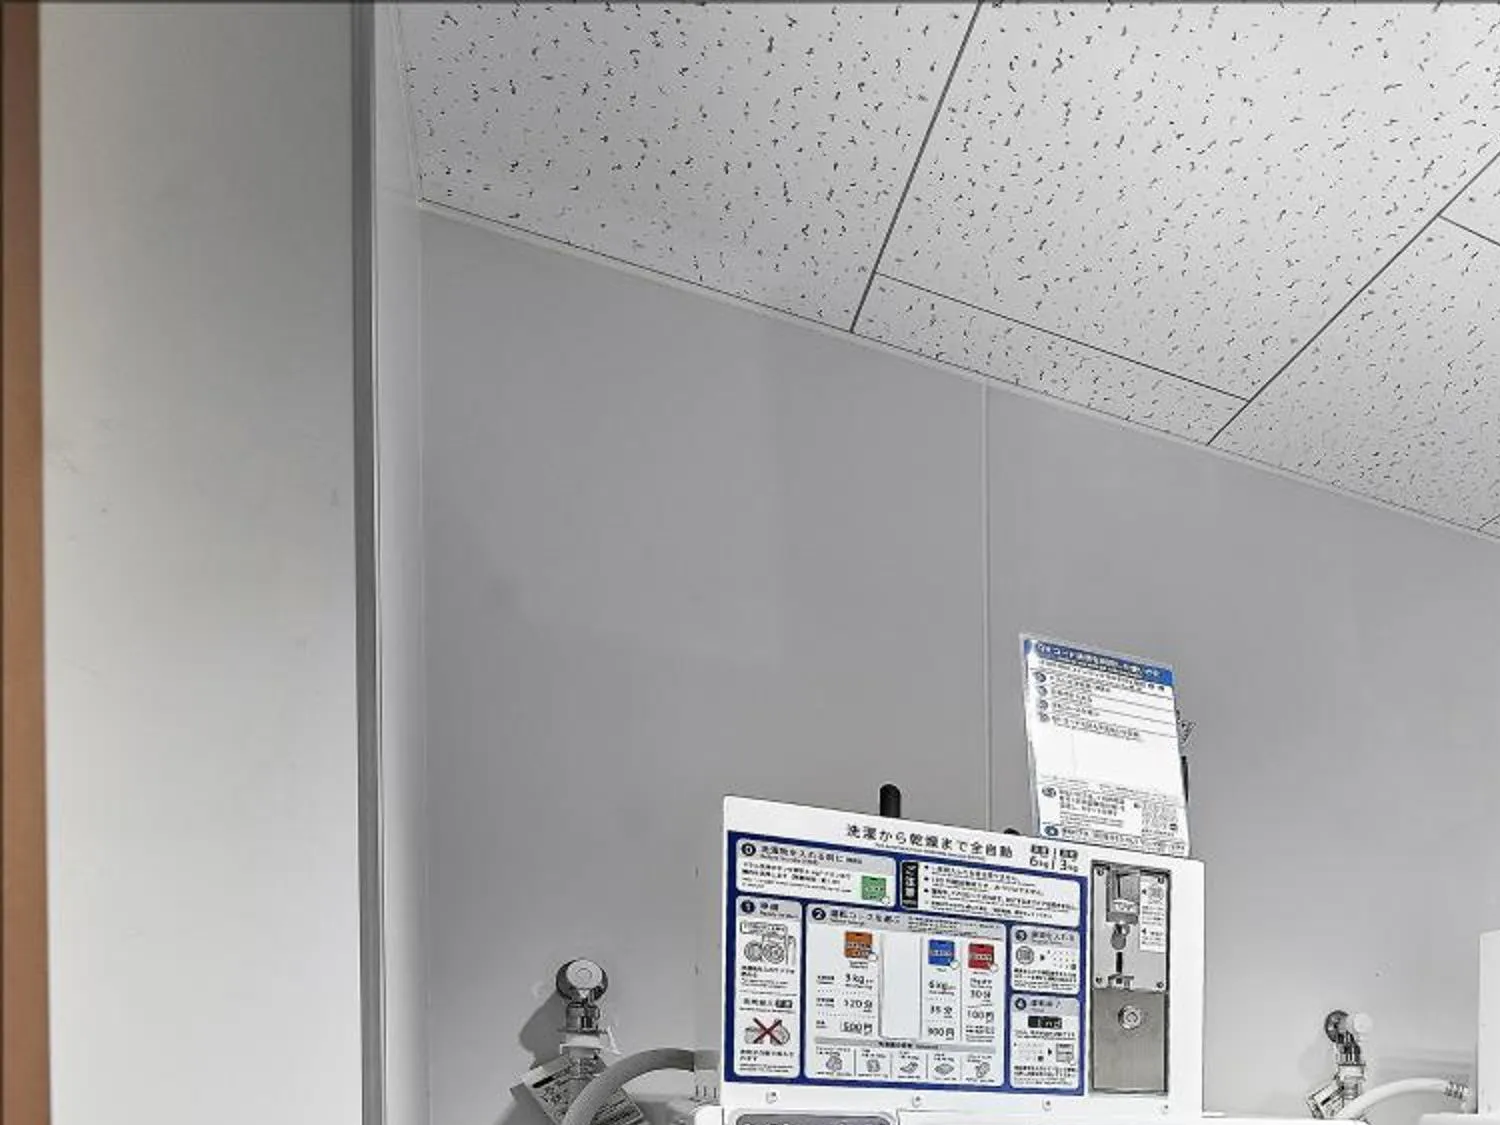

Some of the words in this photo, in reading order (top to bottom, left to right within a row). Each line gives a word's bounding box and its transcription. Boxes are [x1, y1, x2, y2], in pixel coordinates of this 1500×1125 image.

[847, 823, 1013, 859] 洗濯から乾燥まで全自動
